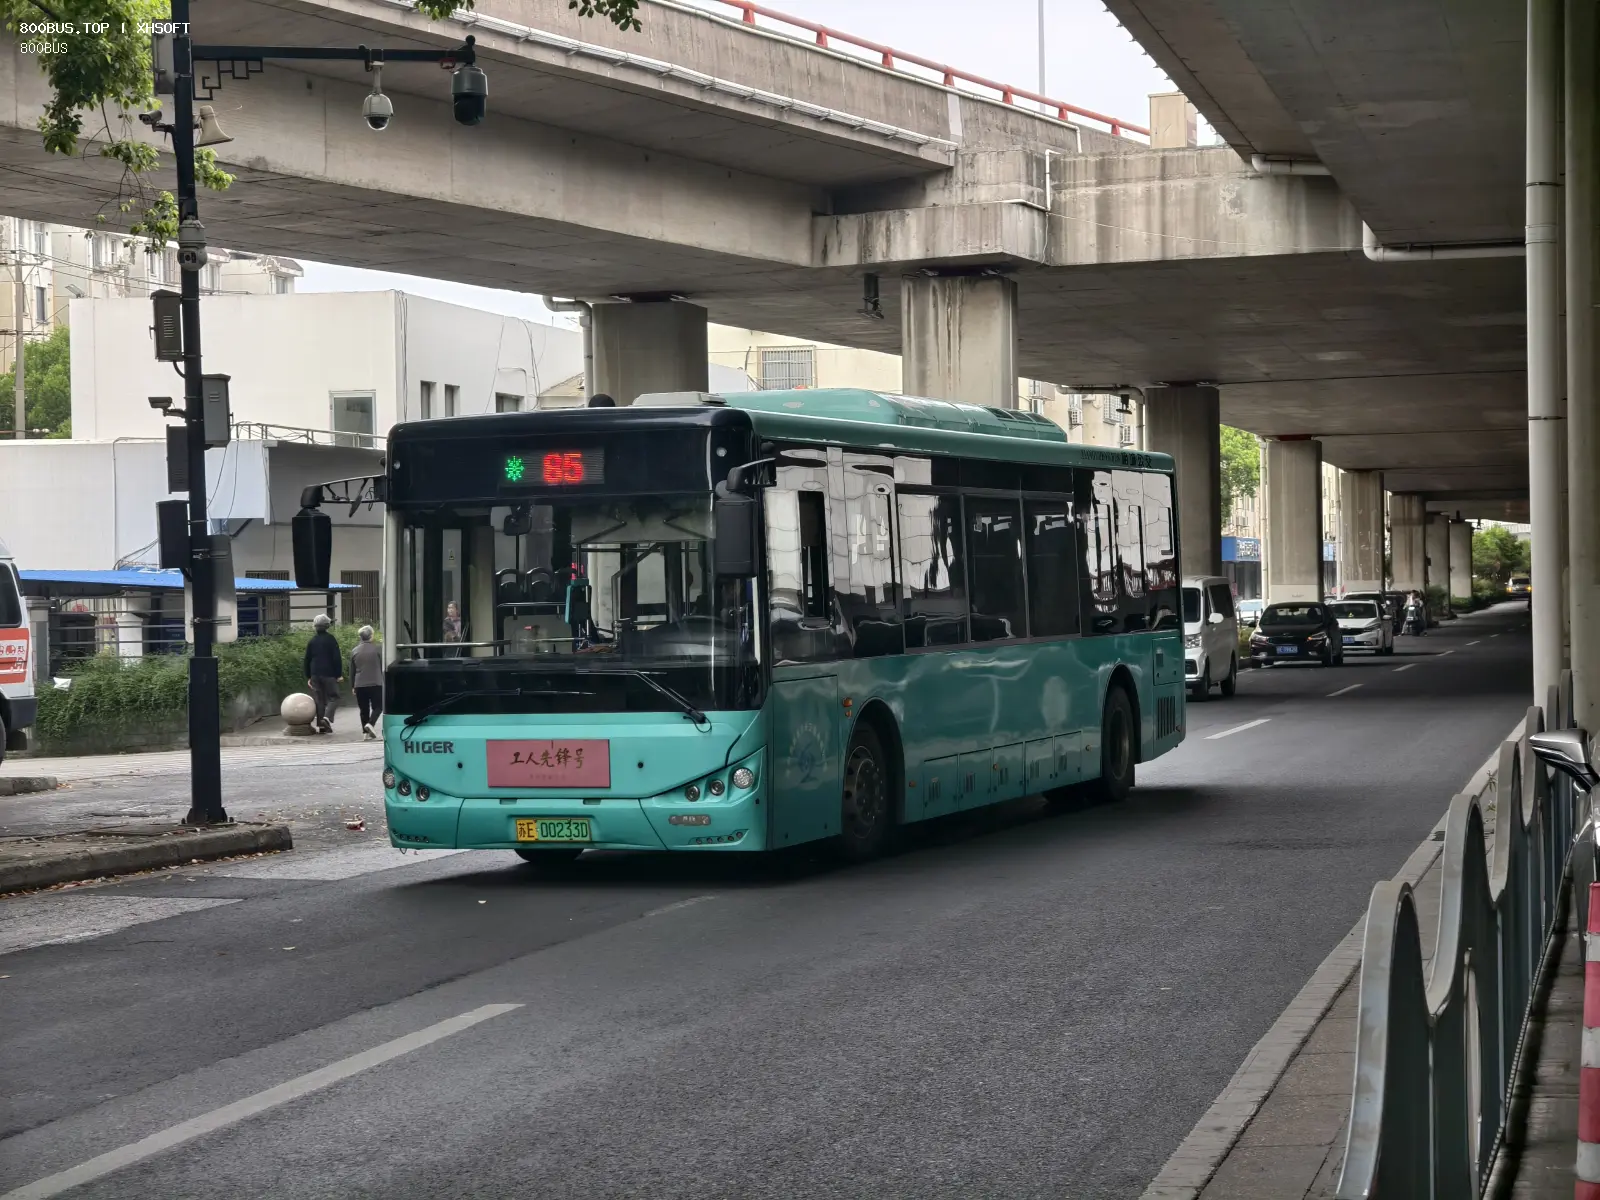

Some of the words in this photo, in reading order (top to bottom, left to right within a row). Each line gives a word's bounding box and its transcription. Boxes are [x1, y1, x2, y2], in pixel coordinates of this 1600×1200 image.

[543, 452, 584, 484] 85
[404, 740, 455, 754] HIGER
[510, 748, 585, 769] 工人先锋号
